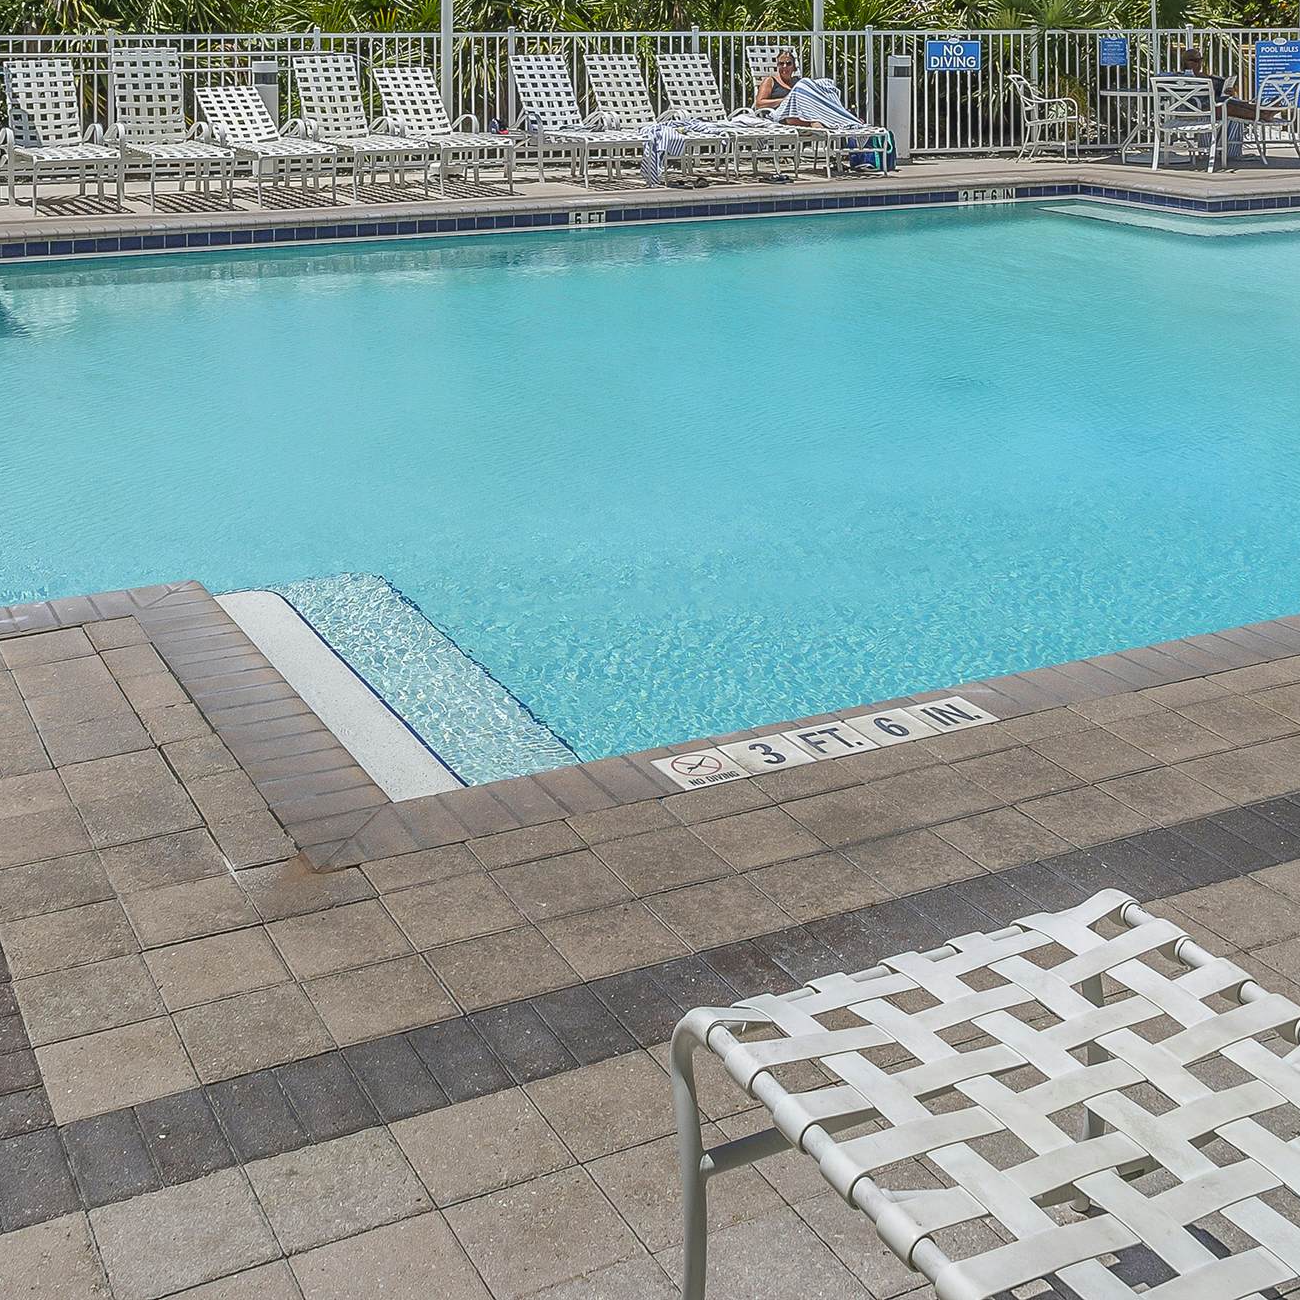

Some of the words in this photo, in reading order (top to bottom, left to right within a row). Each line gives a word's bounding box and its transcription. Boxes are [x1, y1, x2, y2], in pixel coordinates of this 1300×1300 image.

[943, 45, 963, 56] NO
[931, 57, 976, 67] DIVING
[973, 189, 987, 201] FT
[1002, 187, 1014, 200] IN
[588, 212, 604, 223] FT
[748, 742, 787, 765] 3
[797, 727, 864, 755] FT.
[873, 716, 911, 737] 6
[920, 703, 982, 727] IN.
[688, 778, 706, 787] NO
[705, 770, 741, 783] DIVING
